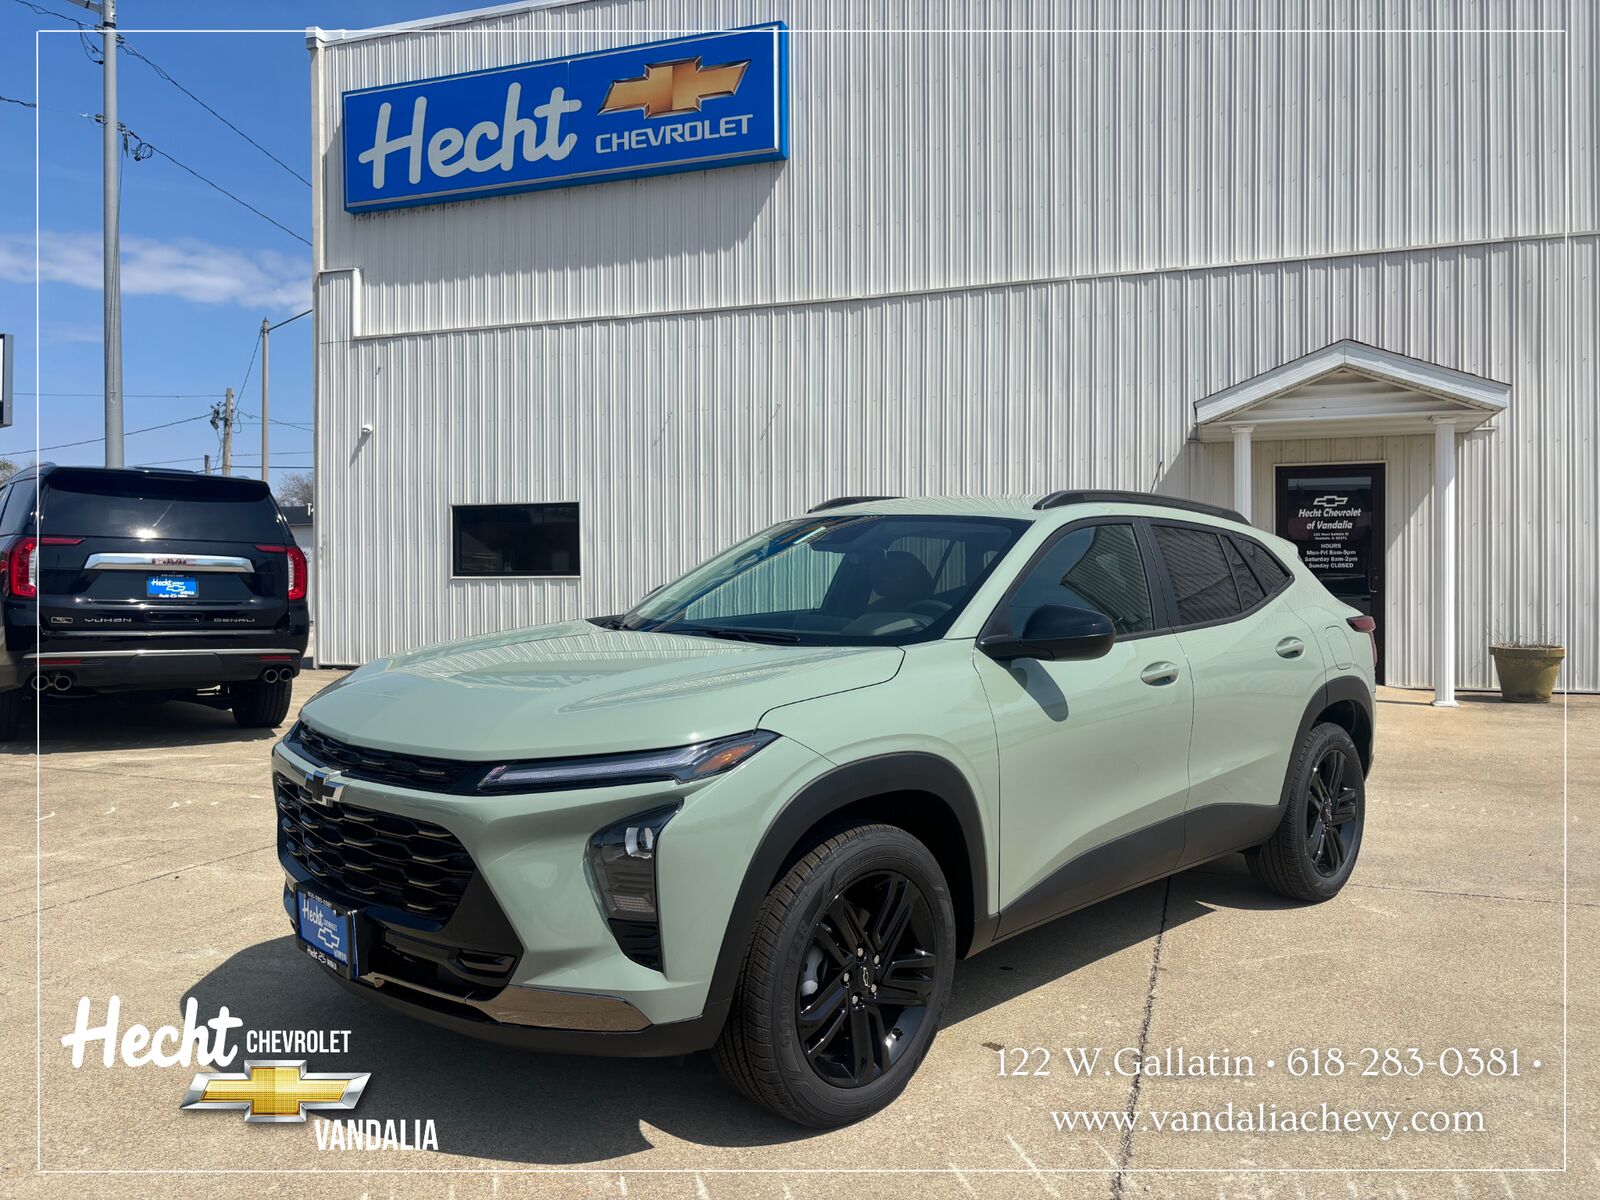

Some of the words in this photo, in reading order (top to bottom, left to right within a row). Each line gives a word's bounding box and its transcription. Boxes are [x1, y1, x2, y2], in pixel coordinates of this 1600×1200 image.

[359, 82, 582, 189] Hecht
[595, 113, 753, 155] CHEVROLET
[1298, 508, 1322, 518] Hecht
[1323, 508, 1361, 517] Chevrolet
[1306, 521, 1315, 530] of
[1316, 520, 1353, 530] Vandalia
[151, 577, 173, 587] Hecht
[302, 898, 325, 928] Hecht
